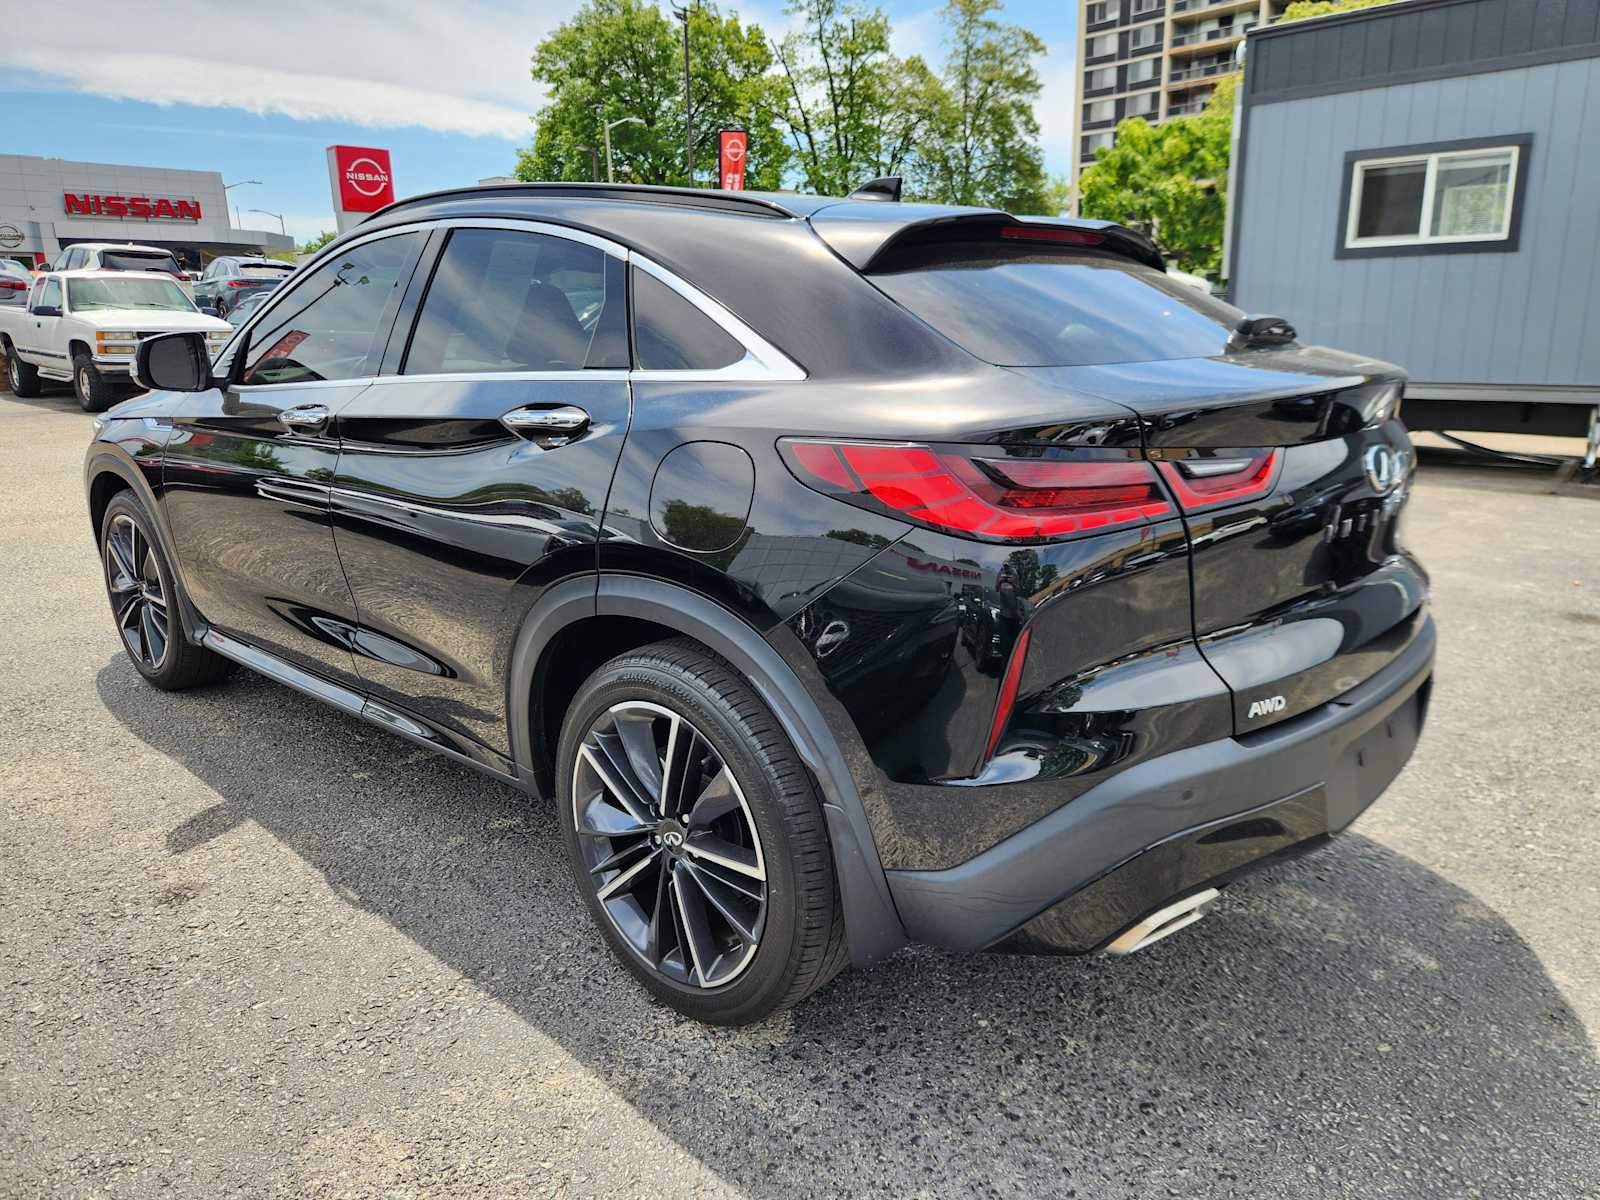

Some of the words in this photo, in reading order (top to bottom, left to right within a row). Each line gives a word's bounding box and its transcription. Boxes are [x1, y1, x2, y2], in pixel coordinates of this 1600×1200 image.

[346, 172, 388, 182] NISSAN
[64, 193, 202, 219] NISSAN
[1247, 695, 1287, 718] AWD
